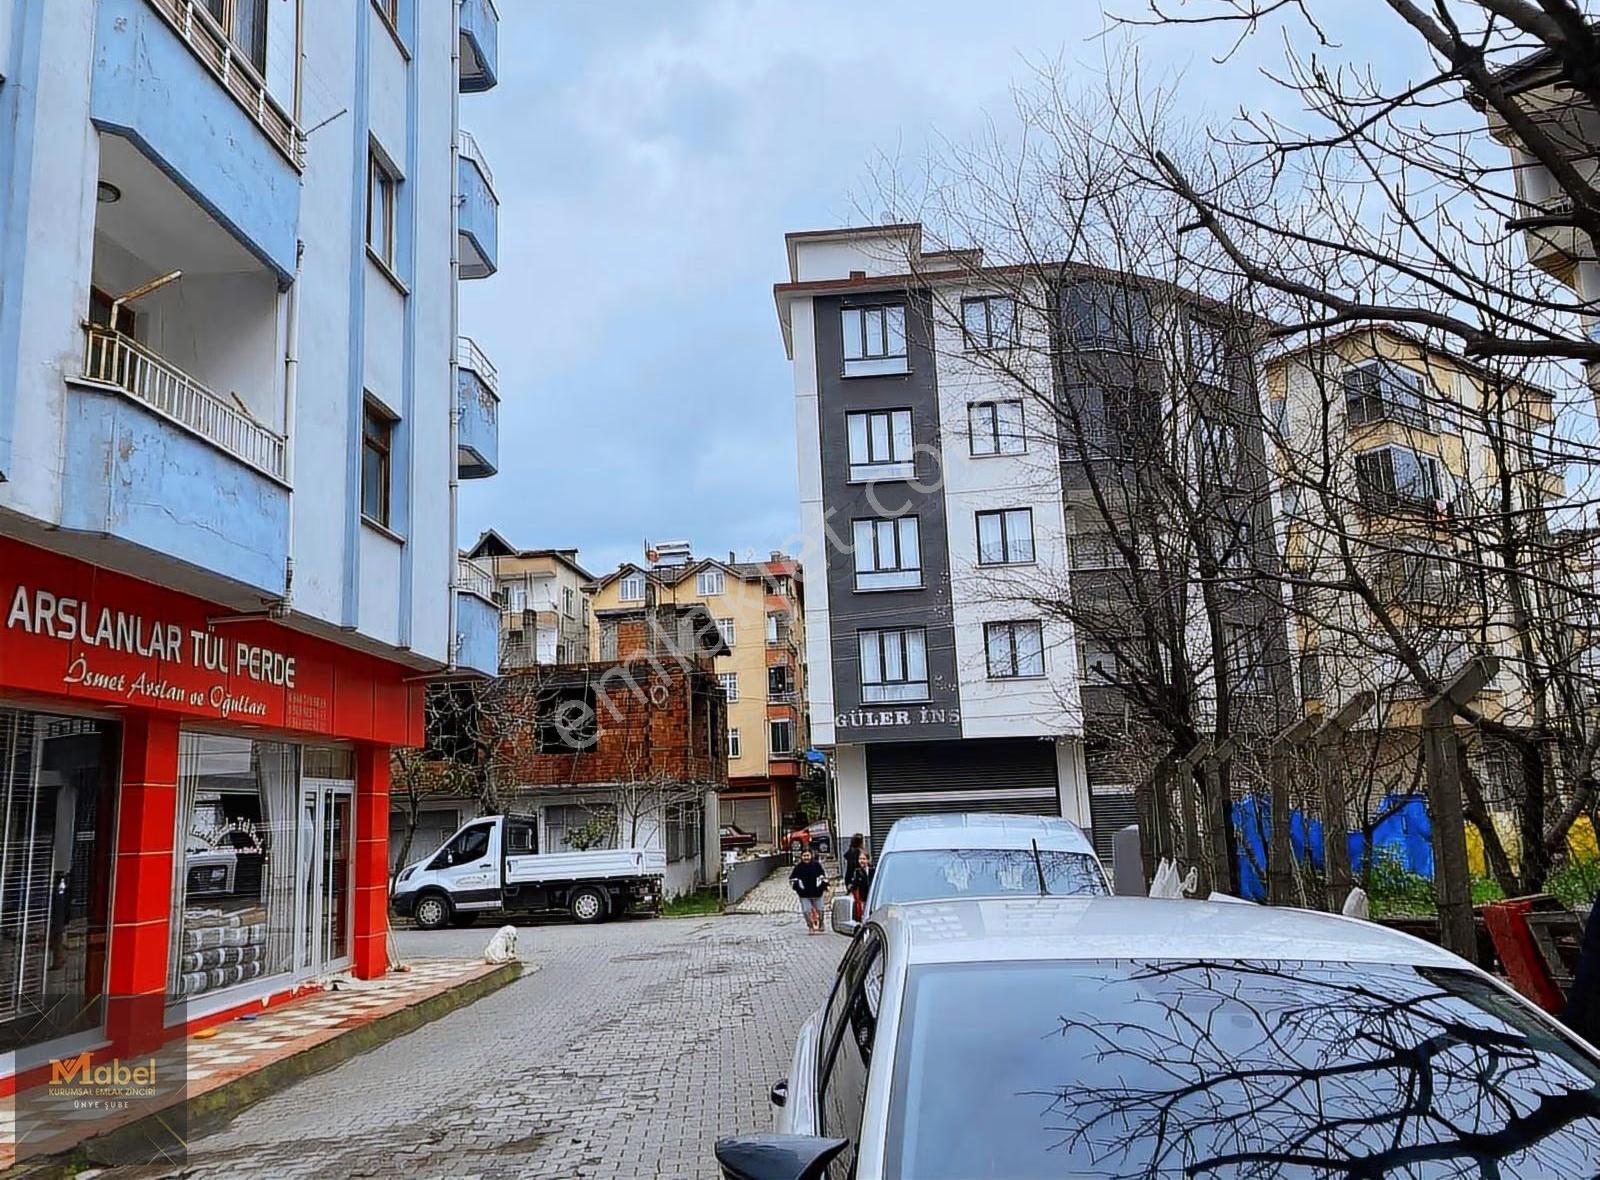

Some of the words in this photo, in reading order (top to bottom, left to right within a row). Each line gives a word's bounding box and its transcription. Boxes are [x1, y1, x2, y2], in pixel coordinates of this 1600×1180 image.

[7, 585, 182, 664] ARSLANLAR
[190, 624, 229, 674] TÜL
[236, 642, 296, 689] PERDE
[63, 652, 126, 691] İsmet
[126, 672, 185, 701] Arslan
[189, 691, 205, 706] ve
[210, 685, 266, 718] Oğulları
[835, 709, 911, 728] GÜLER
